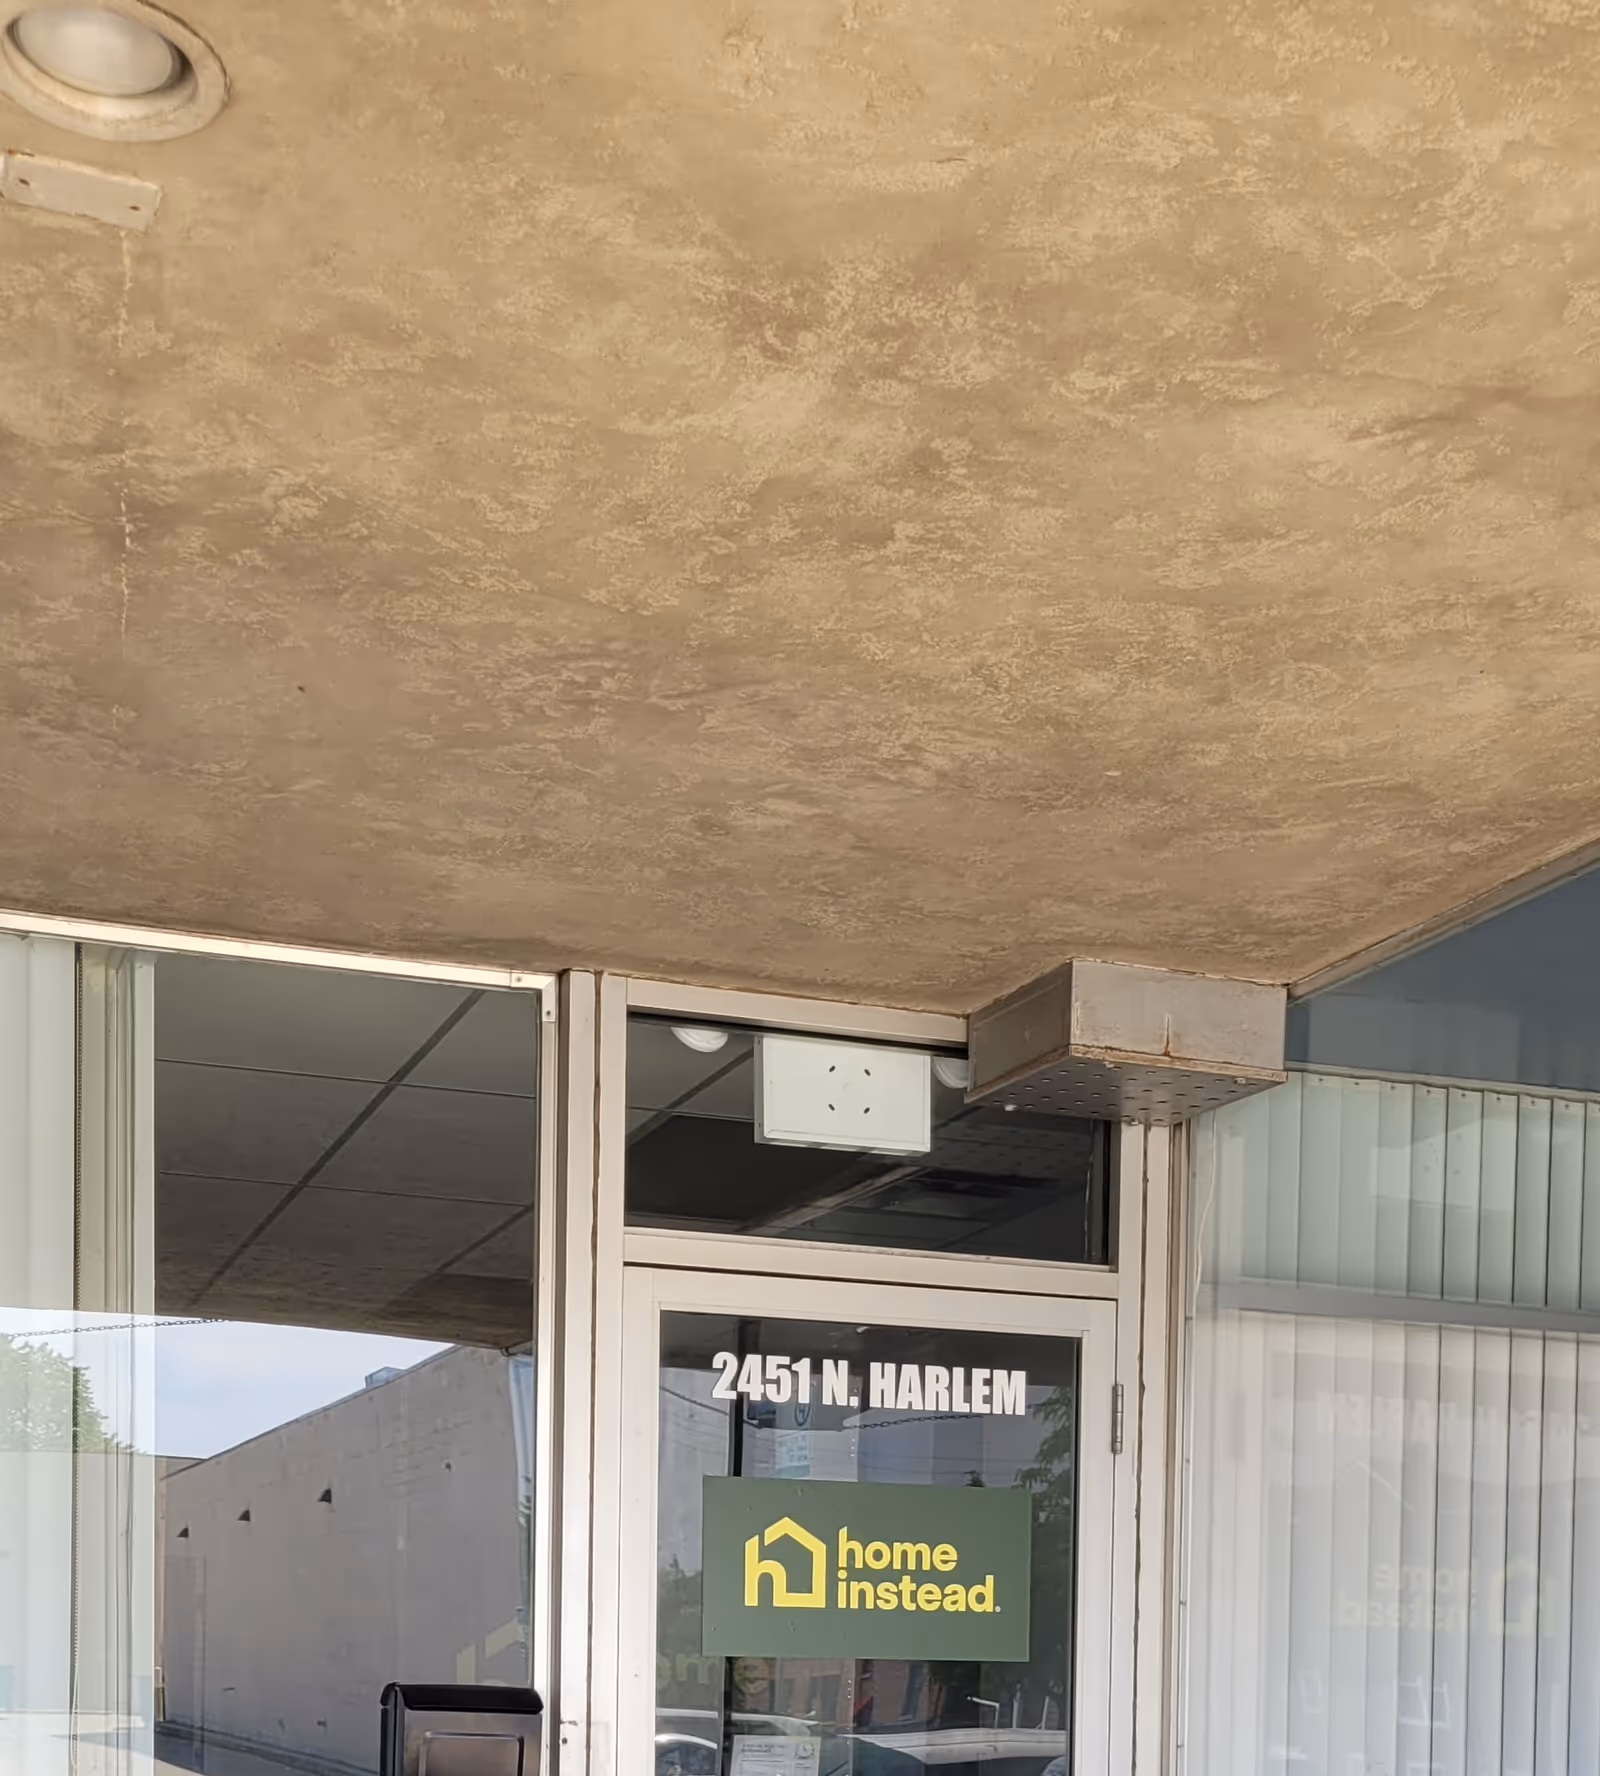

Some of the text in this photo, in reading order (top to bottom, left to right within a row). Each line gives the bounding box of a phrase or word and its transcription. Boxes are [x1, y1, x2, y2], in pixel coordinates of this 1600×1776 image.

[712, 1351, 1027, 1416] 2451 N. HARLEM
[838, 1525, 958, 1572] home
